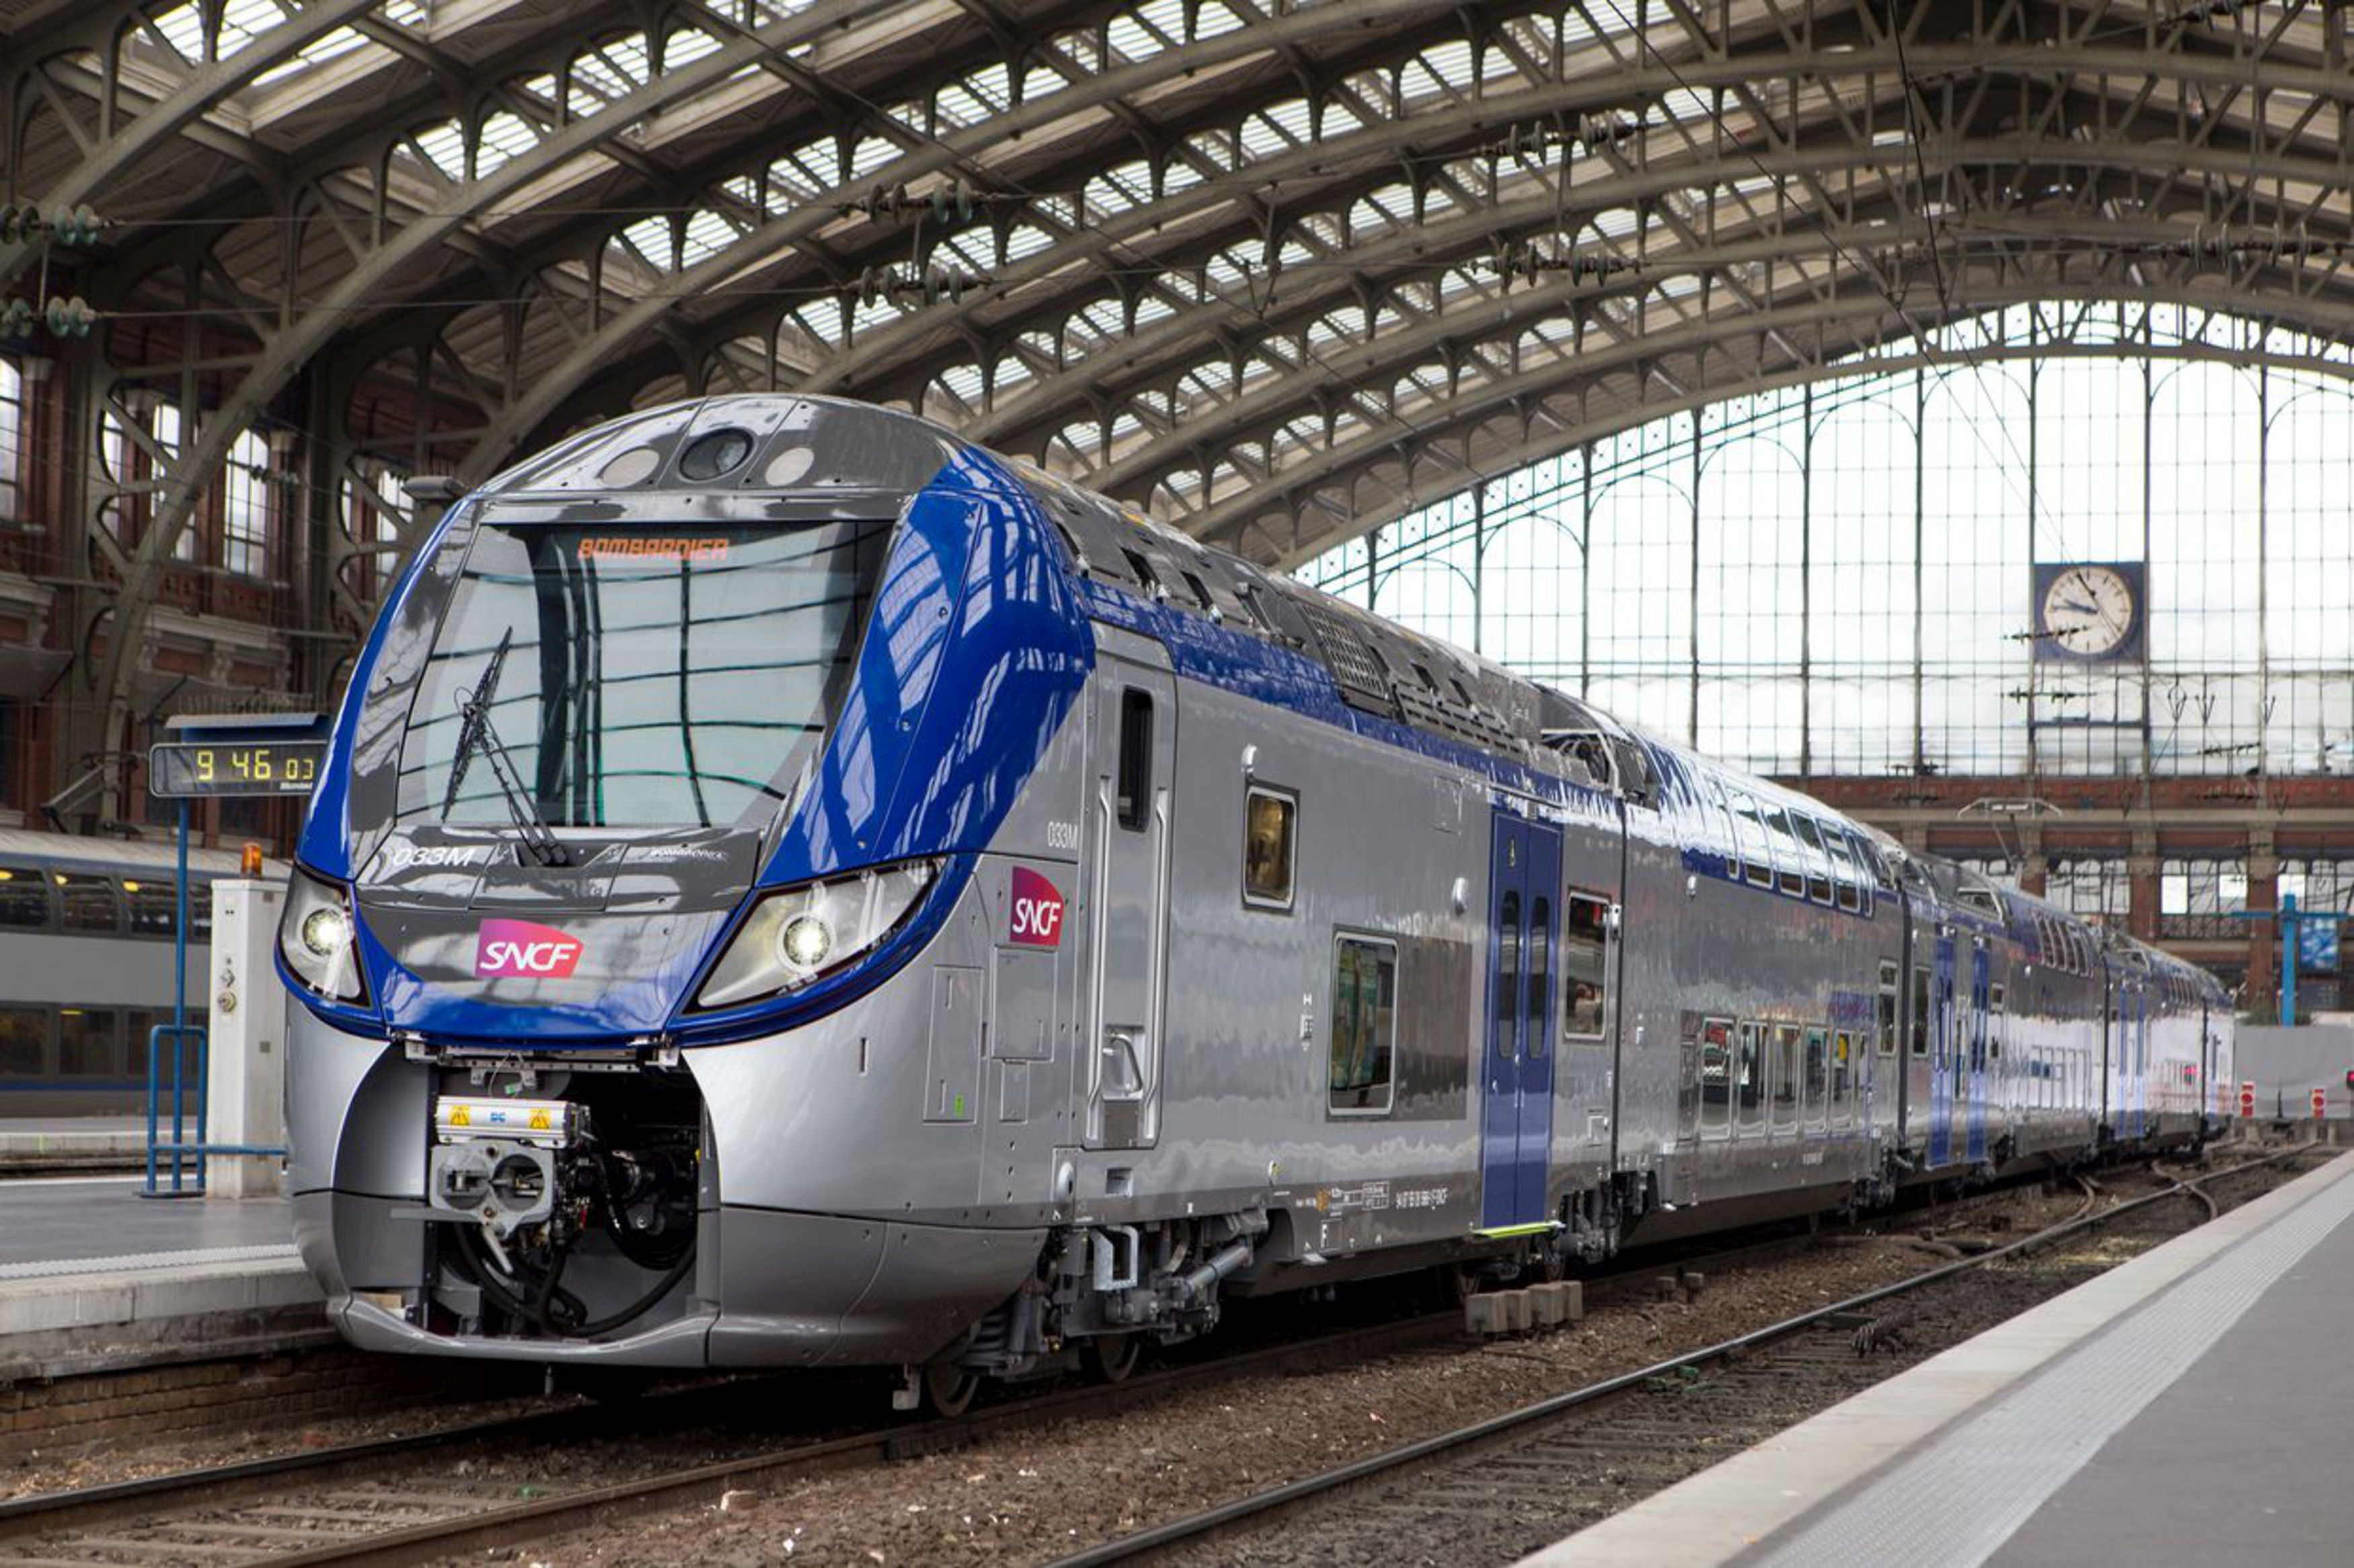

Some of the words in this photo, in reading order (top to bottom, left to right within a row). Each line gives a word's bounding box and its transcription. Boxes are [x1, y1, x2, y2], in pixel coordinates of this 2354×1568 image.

[578, 538, 729, 559] BOMBARDIER
[197, 750, 213, 780] 9
[232, 750, 271, 780] 46
[1047, 821, 1078, 851] 033M
[393, 847, 477, 867] 033M
[1012, 898, 1061, 935] SNCF
[480, 941, 576, 972] SNCF
